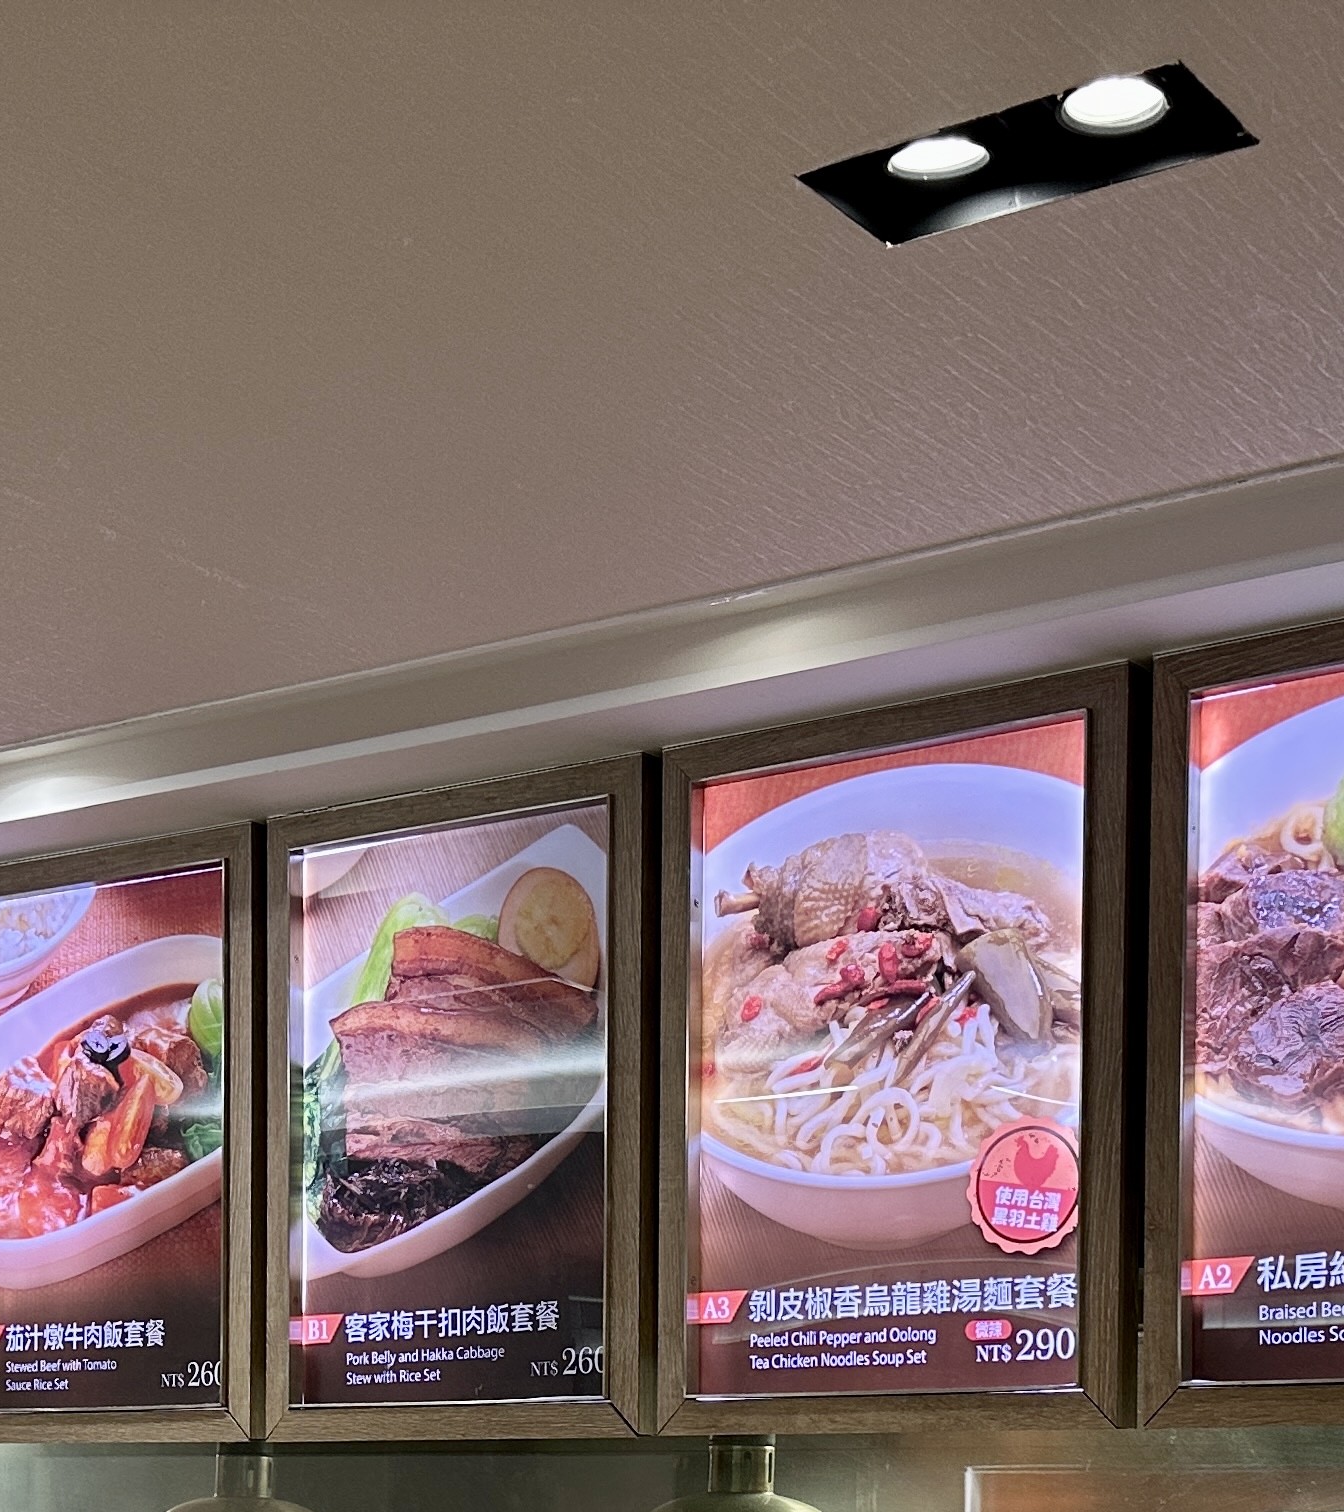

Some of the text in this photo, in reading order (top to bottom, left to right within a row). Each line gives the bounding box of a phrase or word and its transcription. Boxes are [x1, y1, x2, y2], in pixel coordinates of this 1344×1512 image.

[996, 1185, 1061, 1212] 使用台灣
[1198, 1263, 1233, 1291] A2
[702, 1296, 731, 1319] A3
[748, 1271, 1078, 1322] 剝皮椒香烏龍雞湯麵套餐
[344, 1299, 560, 1344] 客家梅干扣肉飯套餐
[1258, 1301, 1317, 1321] Braised
[5, 1318, 166, 1353] 茄汁燉牛肉飯套餐
[307, 1318, 329, 1340] B1
[750, 1327, 936, 1349] Peeled Chili Pepper and Oolong
[1258, 1325, 1326, 1346] Noodles
[975, 1326, 1076, 1363] NT$ 290
[6, 1357, 117, 1373] Stewed Beef with Tomato
[346, 1345, 505, 1367] Pork Belly and Hakka Cabbage
[749, 1347, 927, 1370] Tea Chicken Noodles Soup Set
[346, 1367, 441, 1386] Stew with Rice Set
[530, 1359, 558, 1378] NT$
[6, 1377, 69, 1392] Sauce Rice Set
[160, 1373, 185, 1389] NT$
